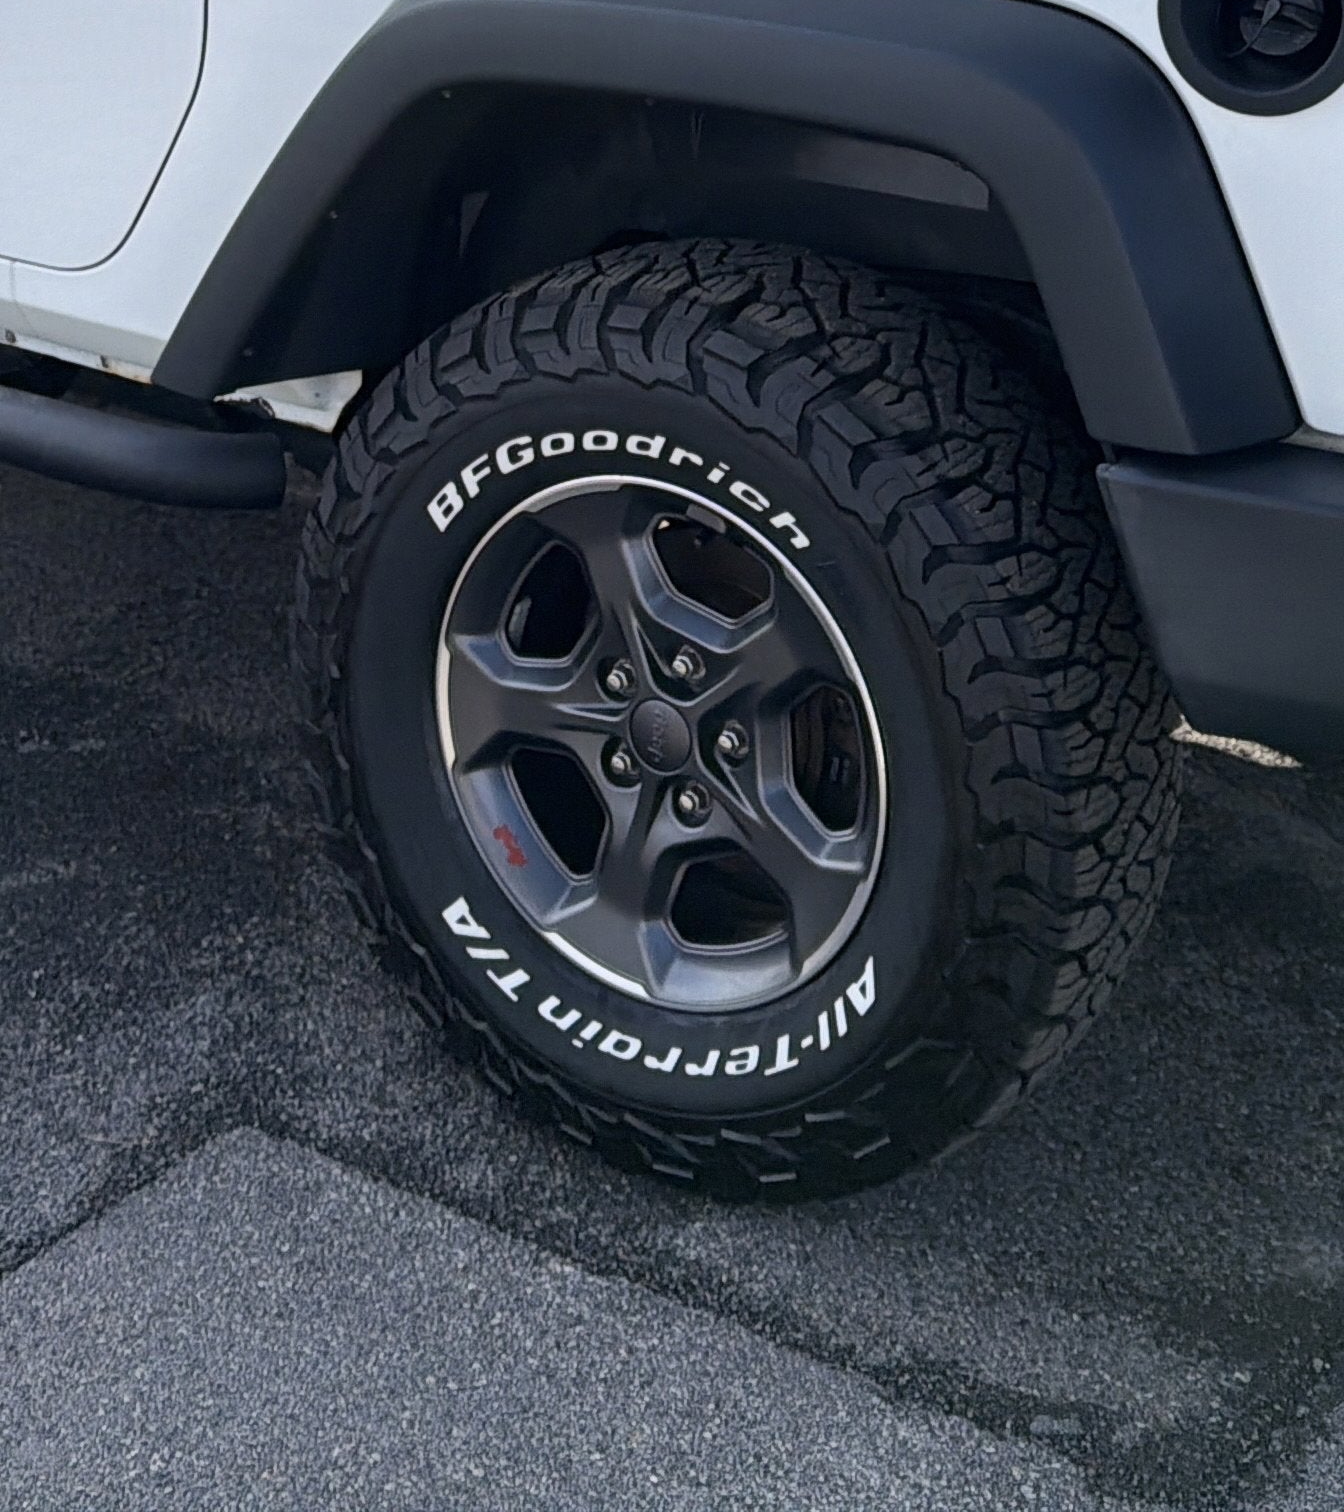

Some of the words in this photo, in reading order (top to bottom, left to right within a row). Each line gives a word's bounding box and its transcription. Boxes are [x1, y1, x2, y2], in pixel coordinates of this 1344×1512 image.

[426, 430, 811, 550] BFGoodrich
[441, 896, 531, 1002] T/A
[537, 956, 876, 1076] All-Terrain
